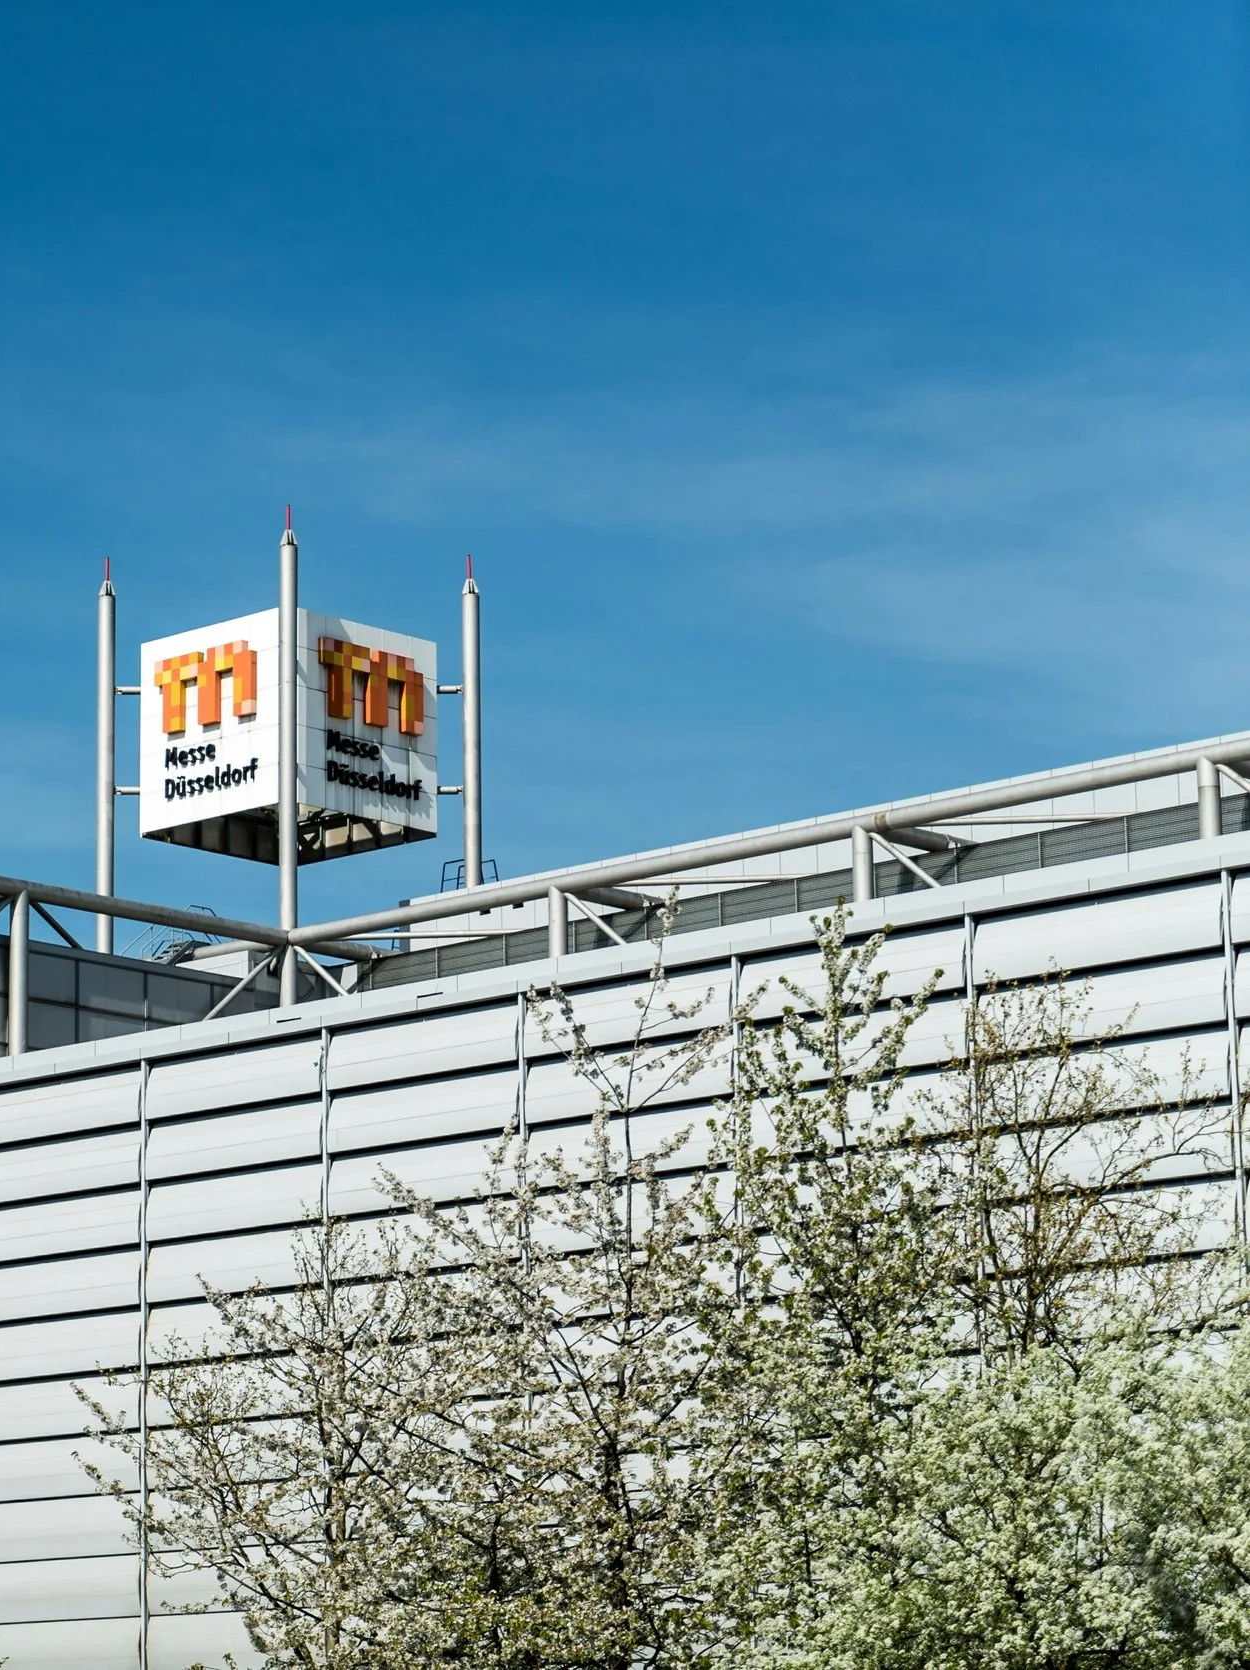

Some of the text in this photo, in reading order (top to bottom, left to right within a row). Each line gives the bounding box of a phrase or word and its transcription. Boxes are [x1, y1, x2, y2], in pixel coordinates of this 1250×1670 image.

[164, 741, 216, 769] Messe
[326, 729, 381, 761] Messe
[164, 757, 259, 800] Düsseldorf
[326, 760, 423, 801] Düsseldorf
